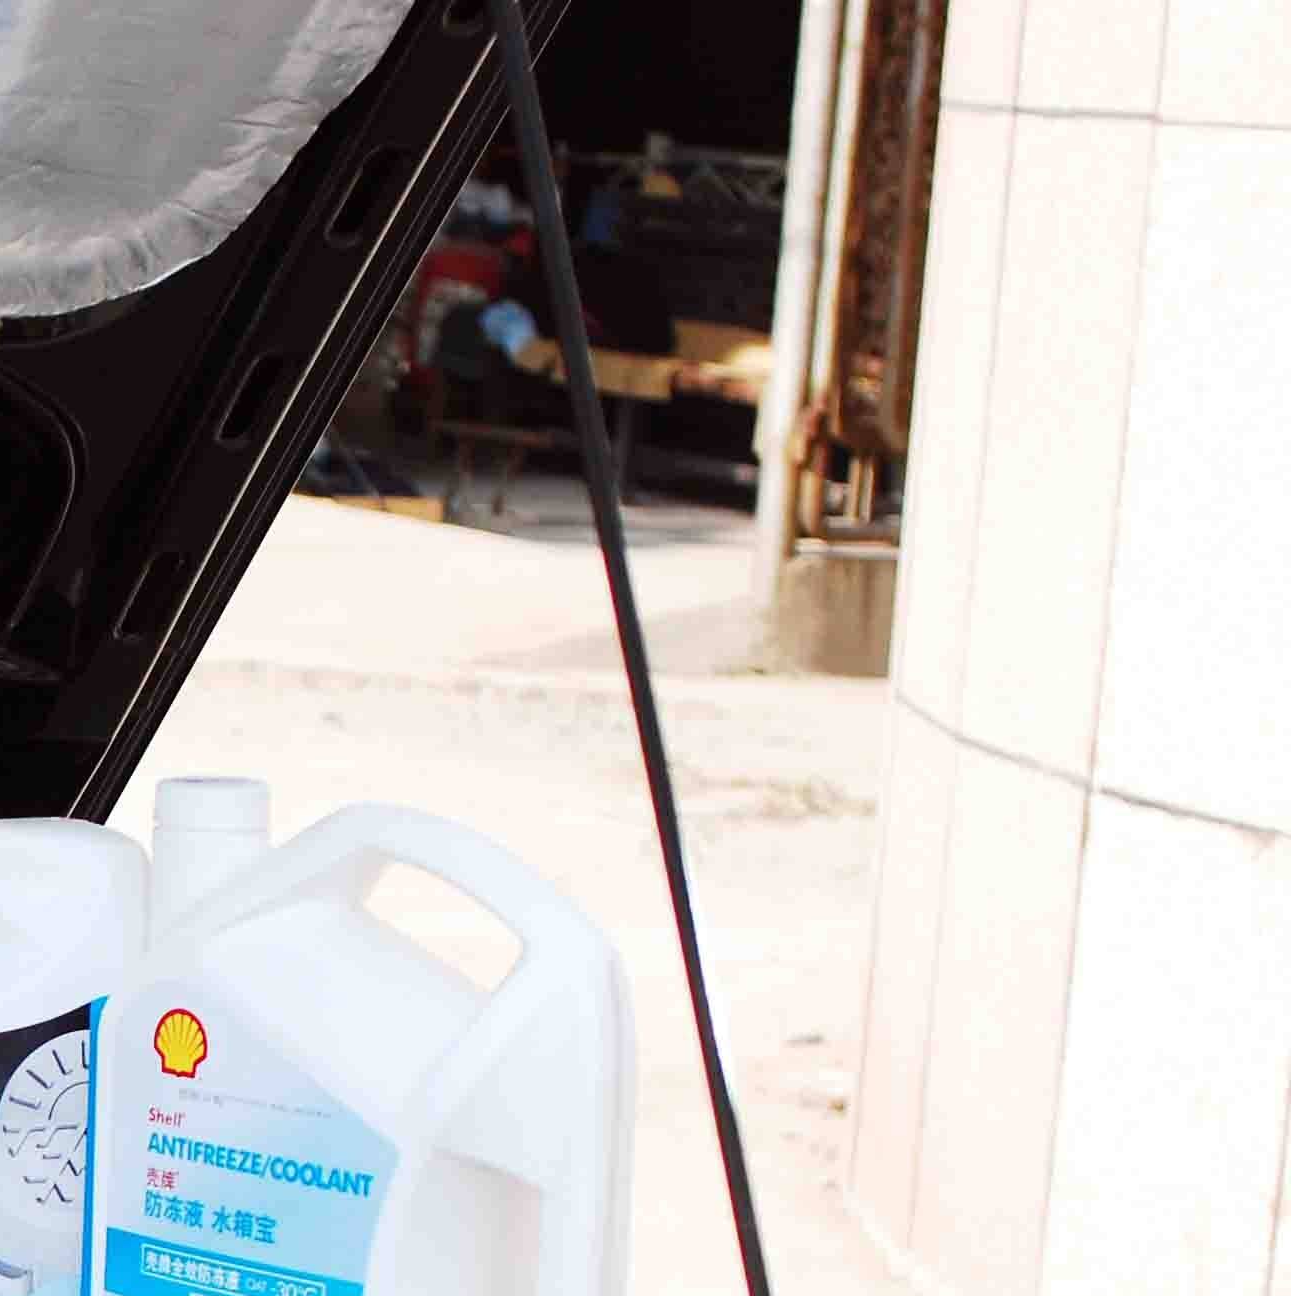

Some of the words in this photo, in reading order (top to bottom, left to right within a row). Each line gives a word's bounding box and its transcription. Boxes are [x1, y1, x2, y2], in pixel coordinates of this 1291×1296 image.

[147, 1107, 182, 1128] Shell
[147, 1132, 373, 1198] ANTIFREEZE/COOLANT
[143, 1189, 205, 1230] 防冻液
[212, 1205, 278, 1245] 水箱宝
